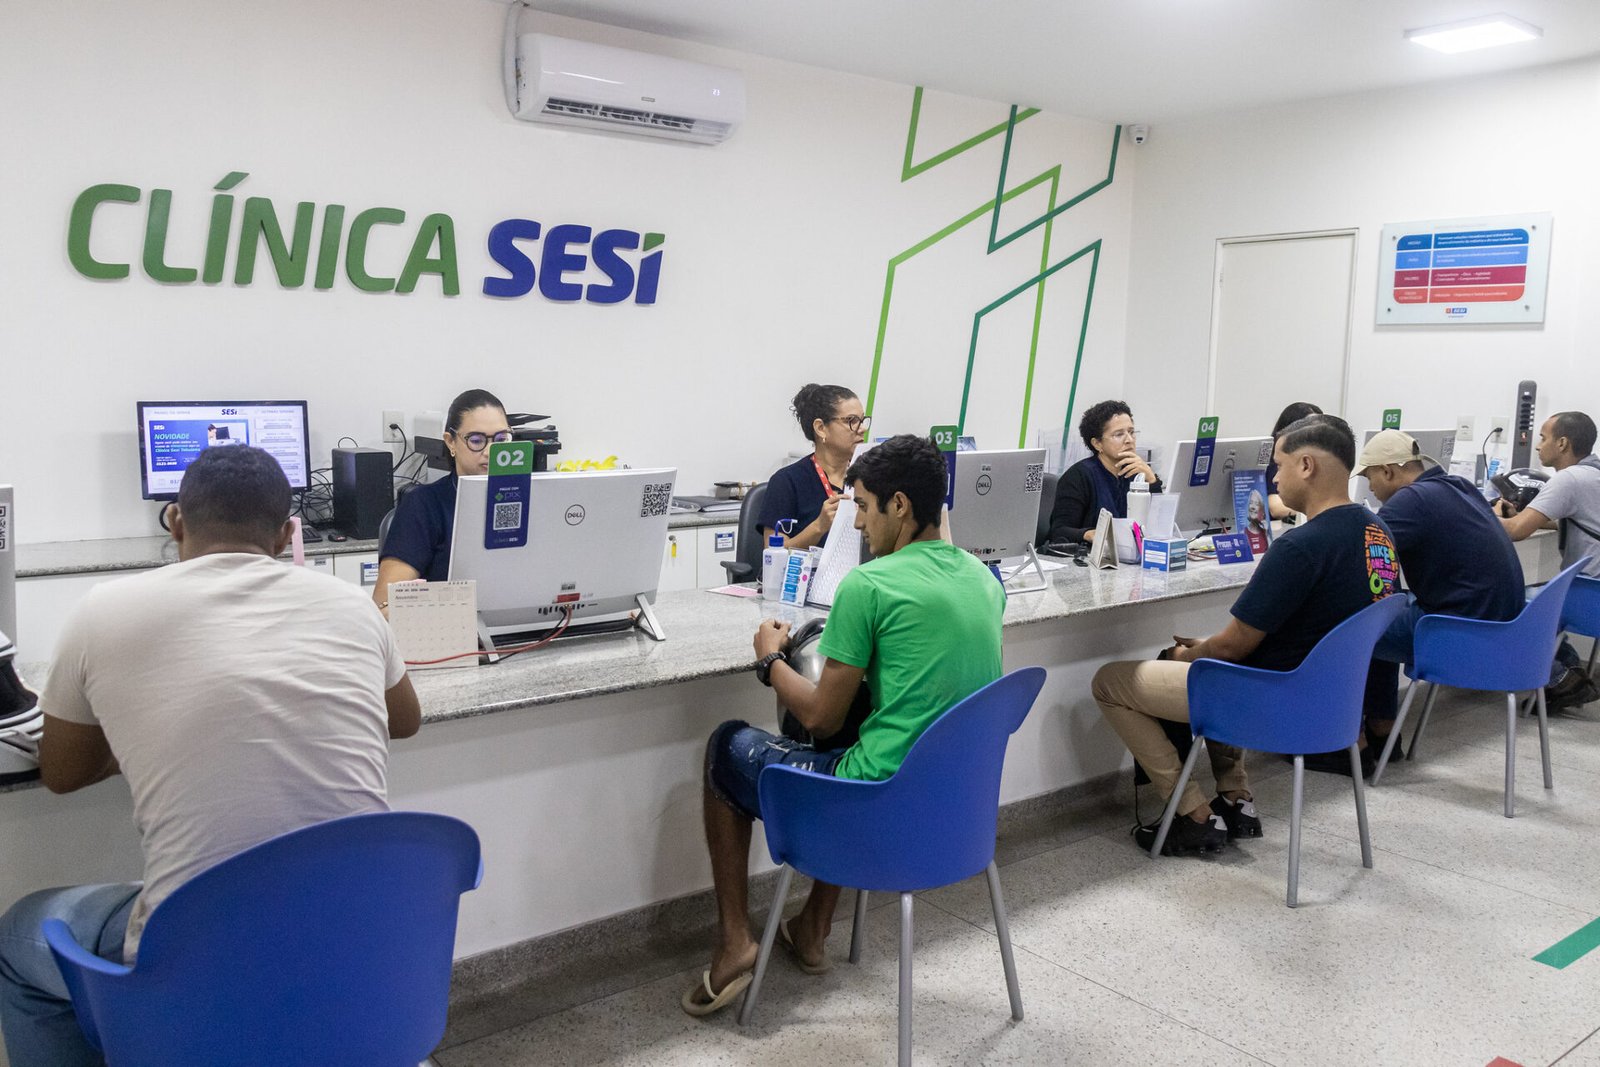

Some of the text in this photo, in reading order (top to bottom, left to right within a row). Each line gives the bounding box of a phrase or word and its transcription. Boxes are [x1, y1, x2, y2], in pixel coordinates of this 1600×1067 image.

[68, 171, 460, 297] CLÍNICA
[1385, 413, 1399, 423] 05
[1201, 422, 1215, 433] 04
[935, 431, 952, 445] 03
[496, 449, 525, 467] 02
[567, 510, 584, 518] DELL
[1369, 544, 1391, 564] NIKE
